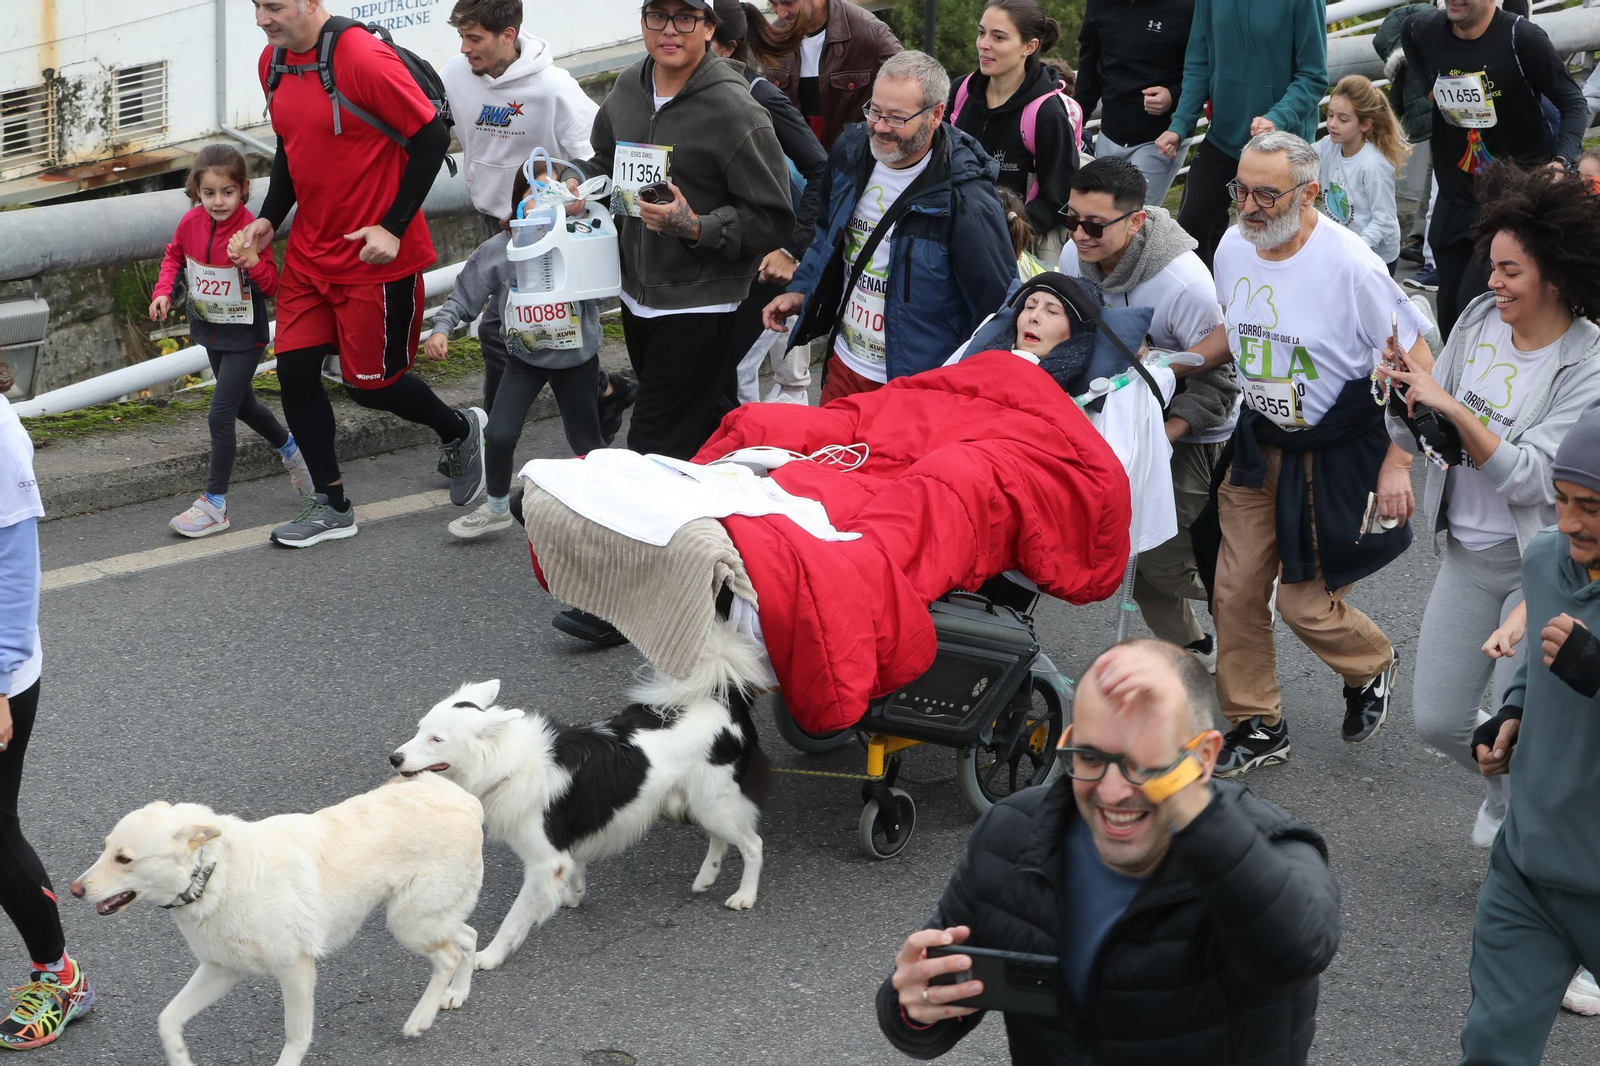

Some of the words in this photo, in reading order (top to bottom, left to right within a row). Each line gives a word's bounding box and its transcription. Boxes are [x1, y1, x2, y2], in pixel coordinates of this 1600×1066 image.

[1440, 89, 1481, 103] 11655
[475, 104, 516, 127] RWC
[621, 162, 661, 183] 11356
[849, 217, 868, 232] ORRO
[195, 276, 231, 296] 9227
[516, 303, 566, 324] 10088
[1239, 323, 1262, 338] CORRO
[1262, 330, 1271, 340] POR
[1271, 333, 1280, 342] LOS
[1280, 335, 1291, 344] QUE
[1292, 337, 1300, 345] LA
[1239, 336, 1319, 380] ELA
[1242, 386, 1290, 418] 11355
[1492, 411, 1503, 423] LOS
